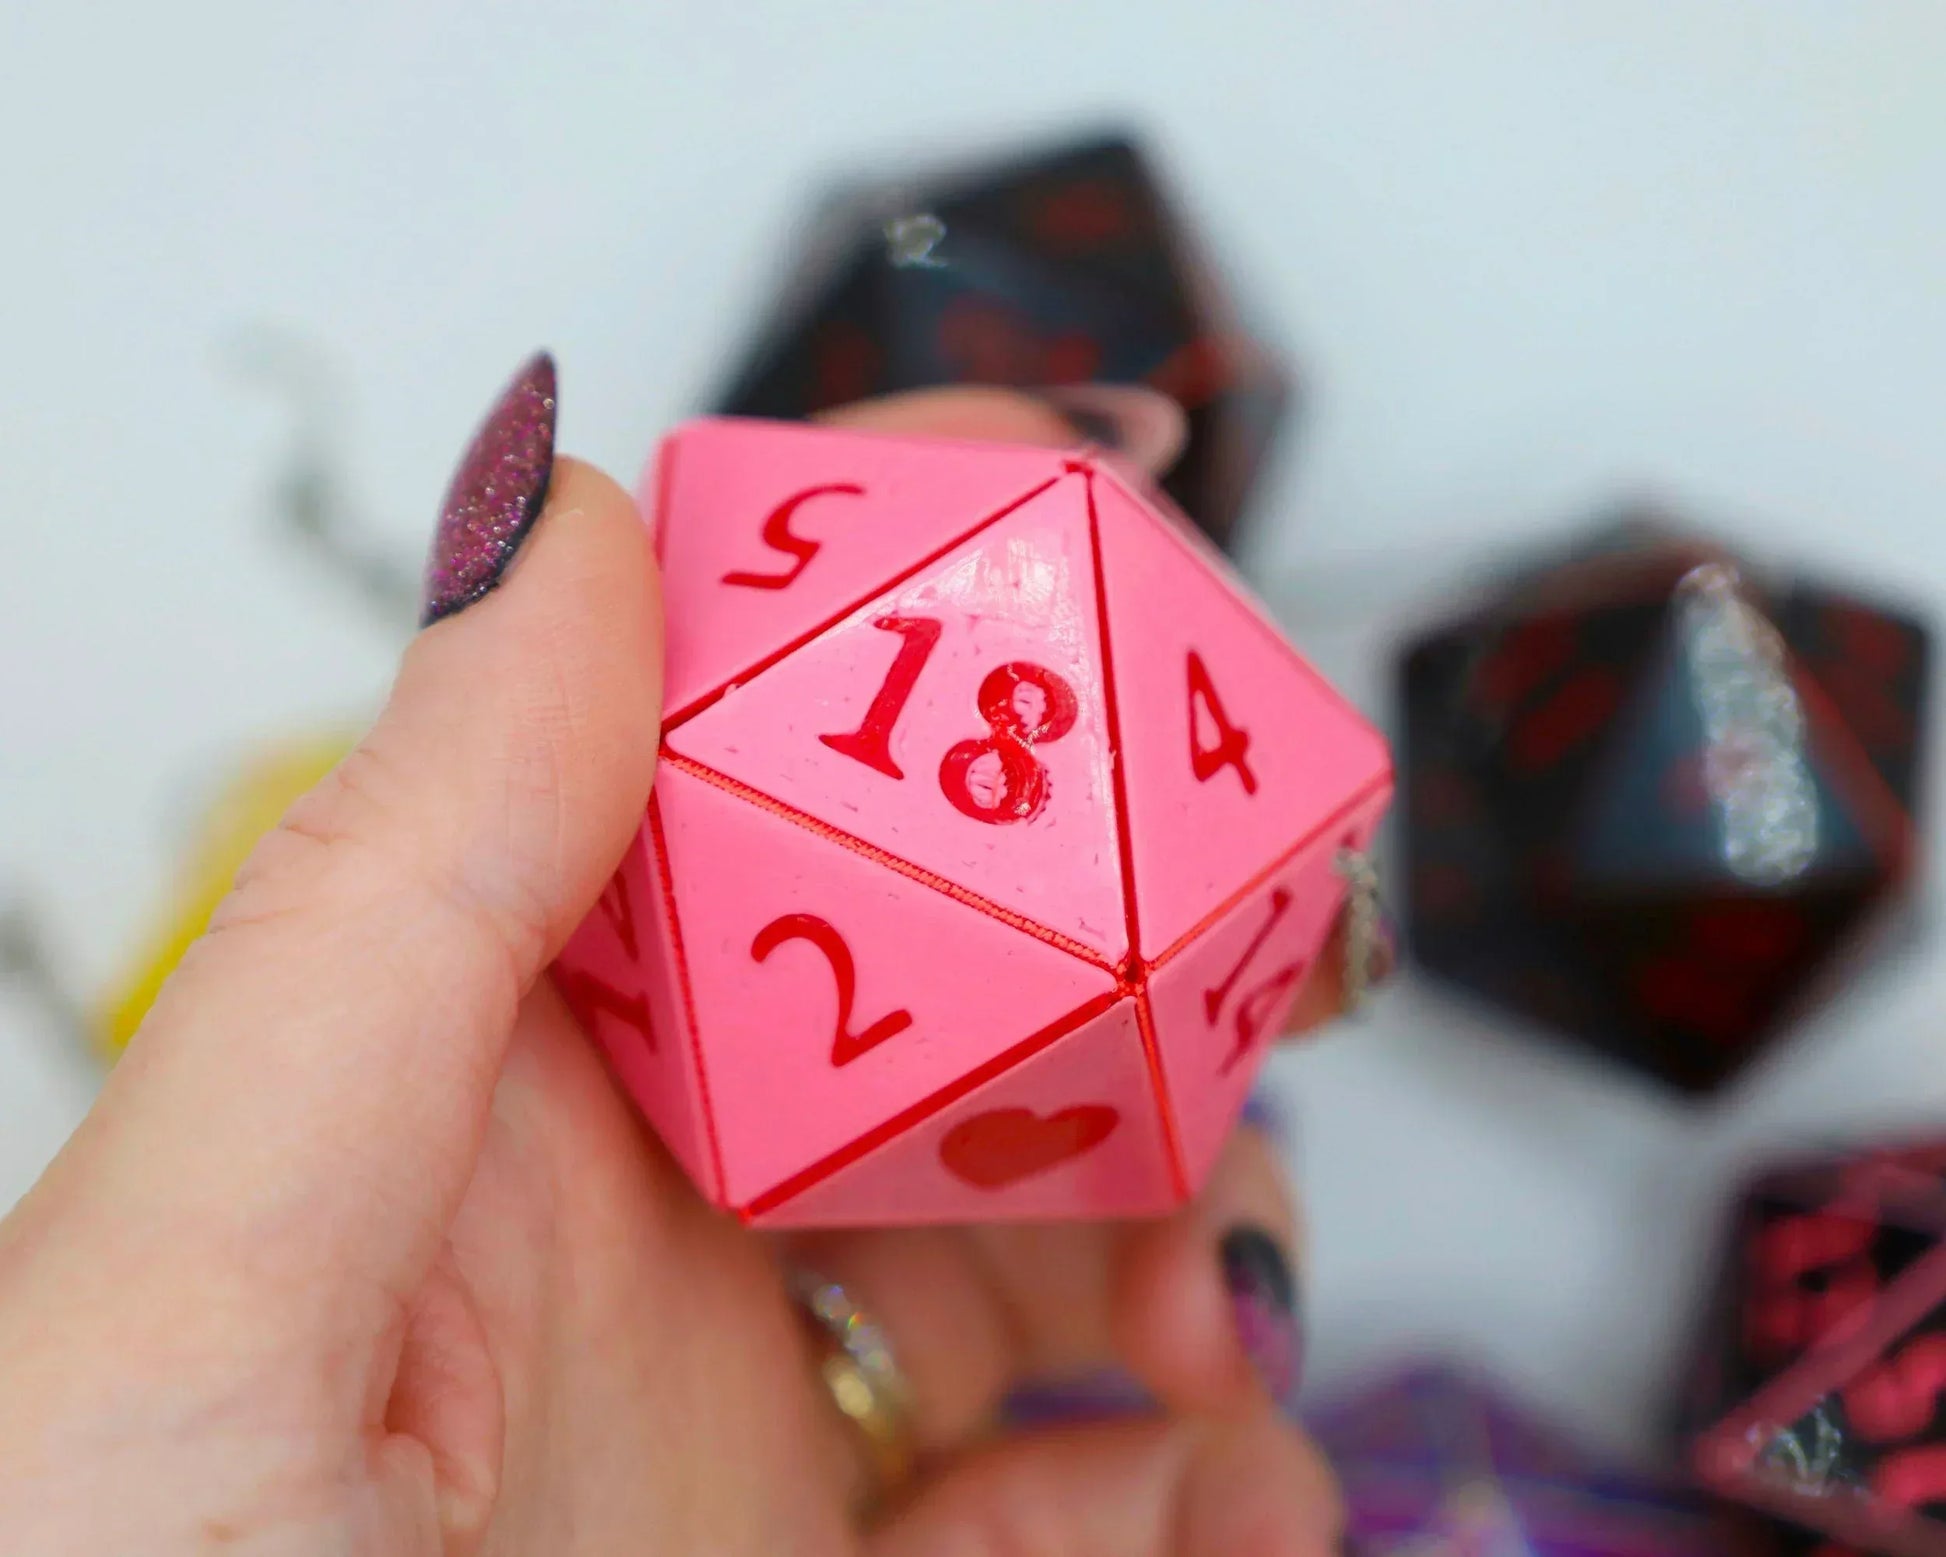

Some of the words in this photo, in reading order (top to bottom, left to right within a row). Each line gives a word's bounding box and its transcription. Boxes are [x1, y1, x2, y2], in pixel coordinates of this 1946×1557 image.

[721, 484, 865, 591] 5
[818, 616, 1078, 826] 18
[1185, 648, 1259, 796] 4
[750, 912, 913, 1069] 2
